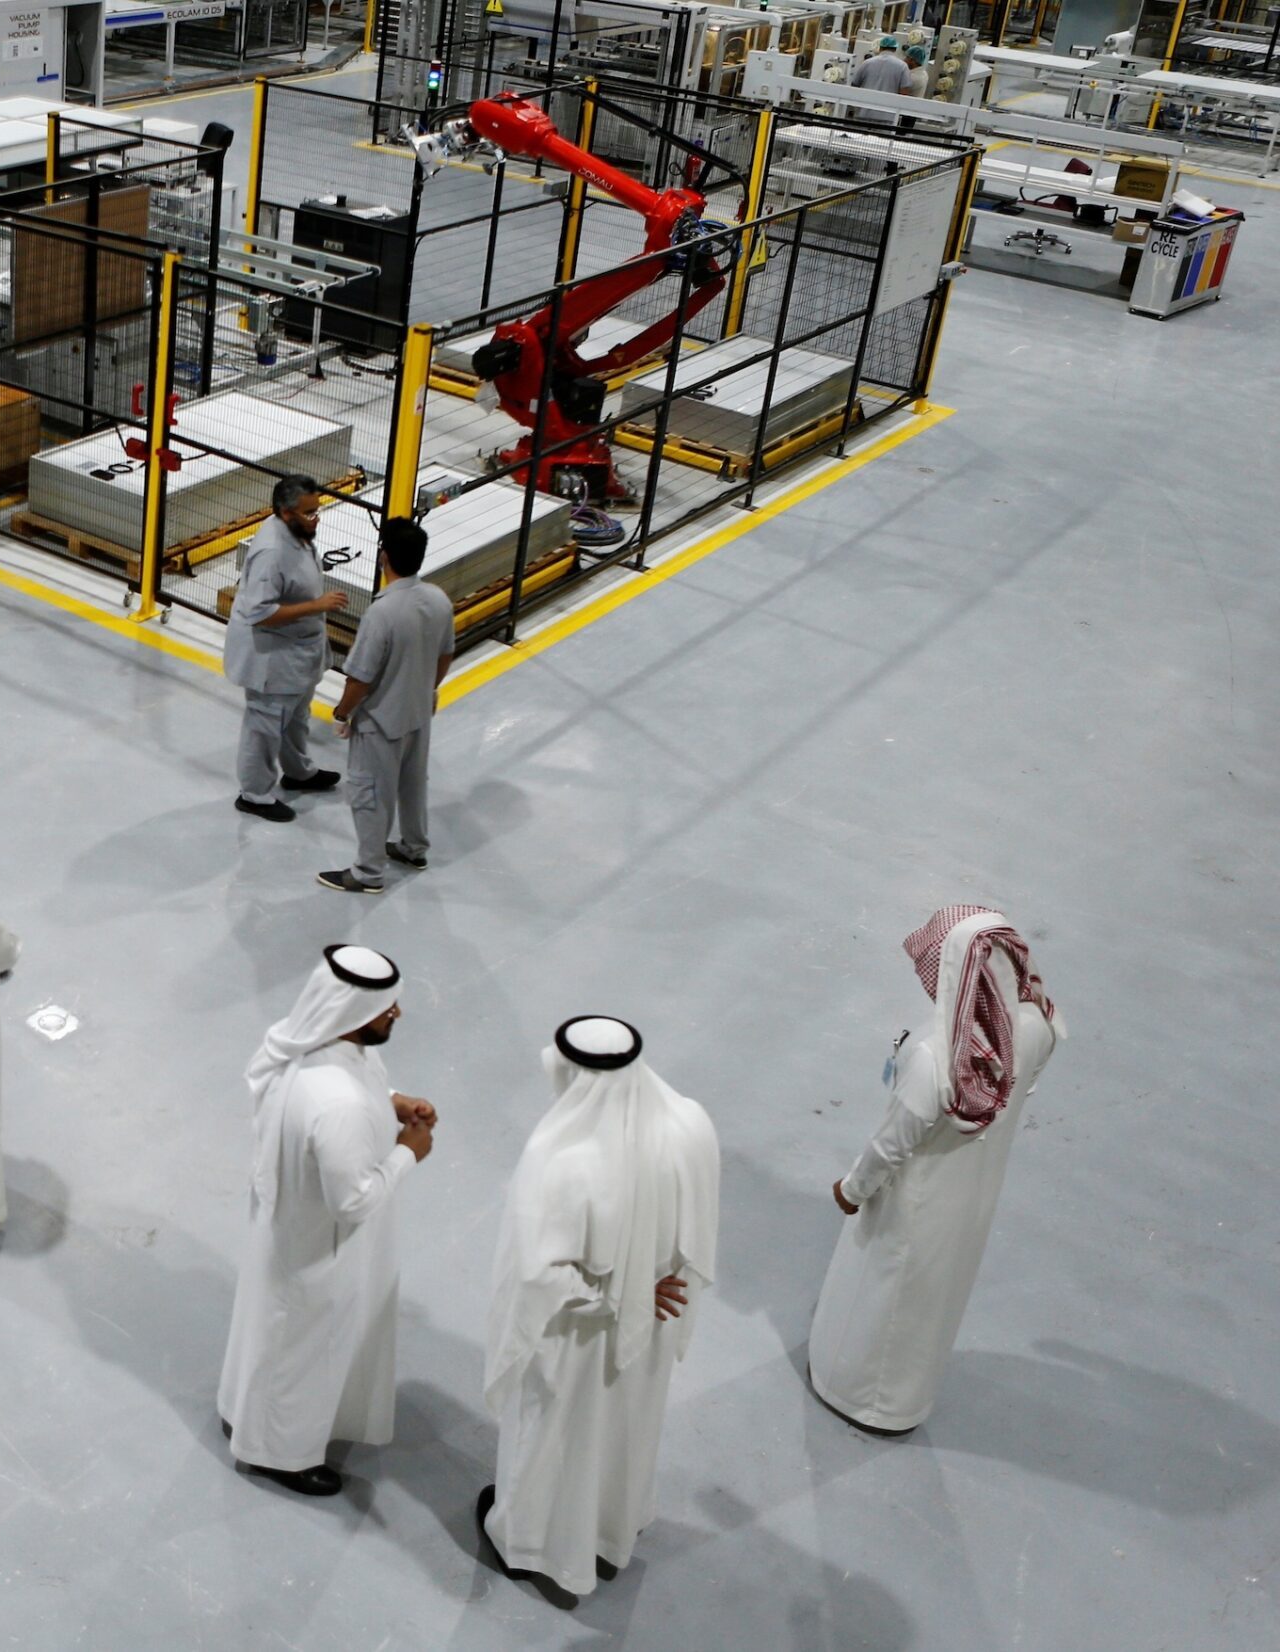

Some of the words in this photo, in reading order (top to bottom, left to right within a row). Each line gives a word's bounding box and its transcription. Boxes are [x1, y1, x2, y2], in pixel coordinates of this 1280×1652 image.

[9, 13, 41, 22] VACUUM
[167, 9, 201, 19] ECOLAM
[18, 21, 40, 29] PUMP
[8, 29, 40, 39] HOUSING
[578, 166, 613, 190] COMAU
[1159, 231, 1177, 245] RE
[1151, 241, 1179, 258] CYCLE
